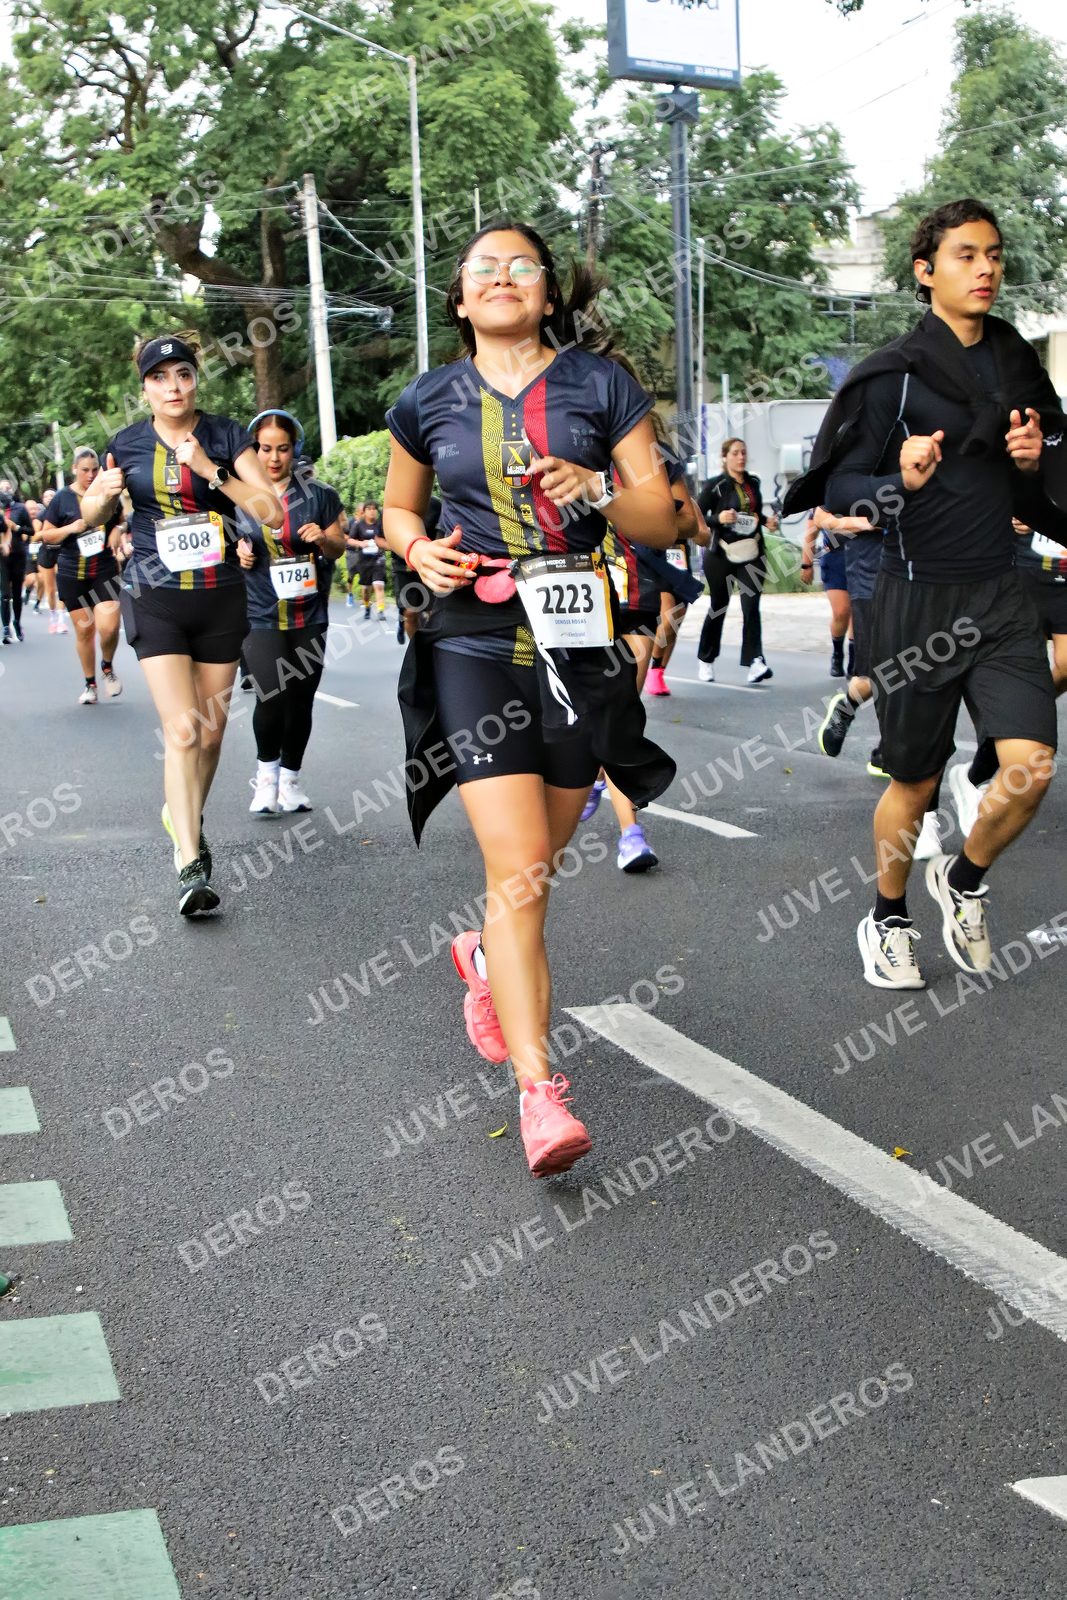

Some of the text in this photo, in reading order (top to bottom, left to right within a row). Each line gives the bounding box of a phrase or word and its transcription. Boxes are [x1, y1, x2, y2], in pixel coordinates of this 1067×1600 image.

[168, 531, 210, 552] 5808
[278, 568, 310, 584] 1784
[536, 584, 594, 614] 2223
